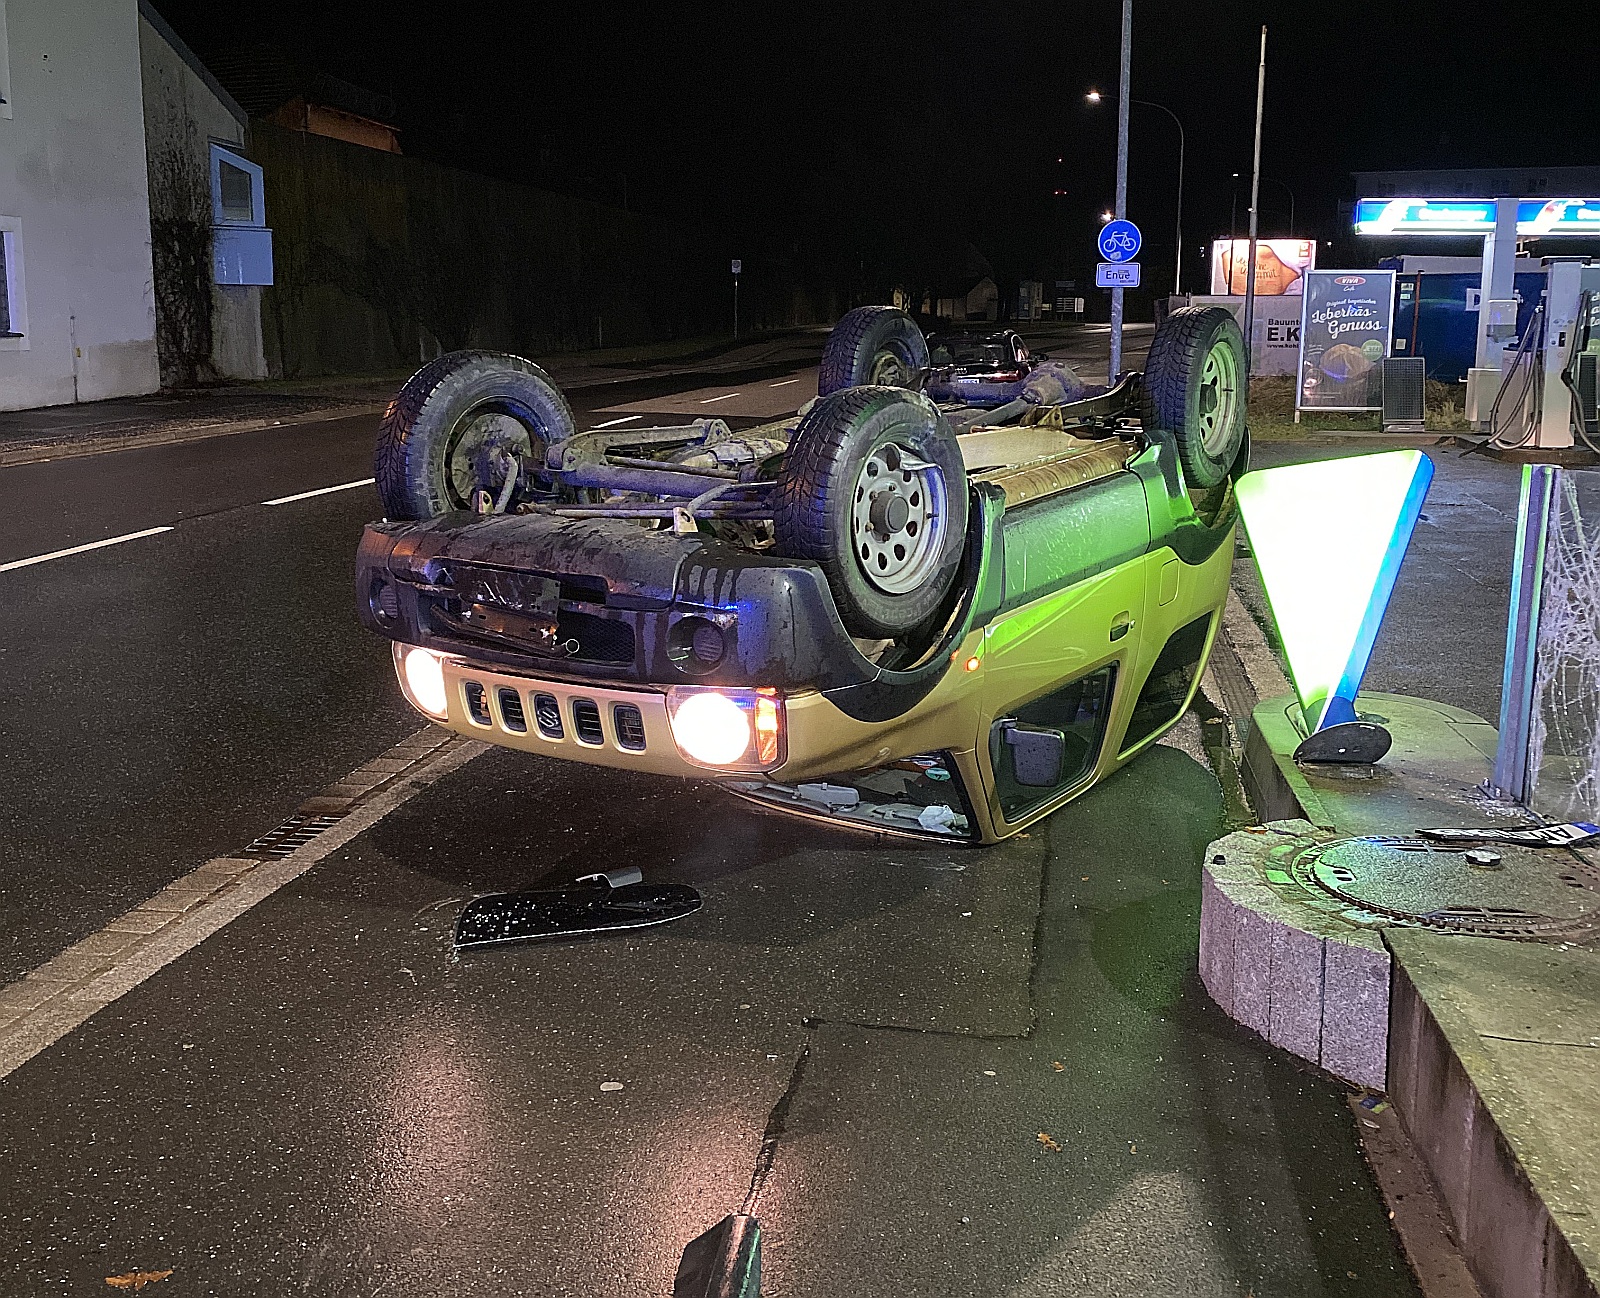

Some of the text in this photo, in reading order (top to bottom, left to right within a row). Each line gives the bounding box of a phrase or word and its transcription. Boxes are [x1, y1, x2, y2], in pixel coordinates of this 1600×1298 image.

[1268, 318, 1300, 326] Bauunt
[1312, 305, 1377, 323] Leberkäs-
[1267, 327, 1300, 341] E.K
[1328, 320, 1384, 339] Genuss
